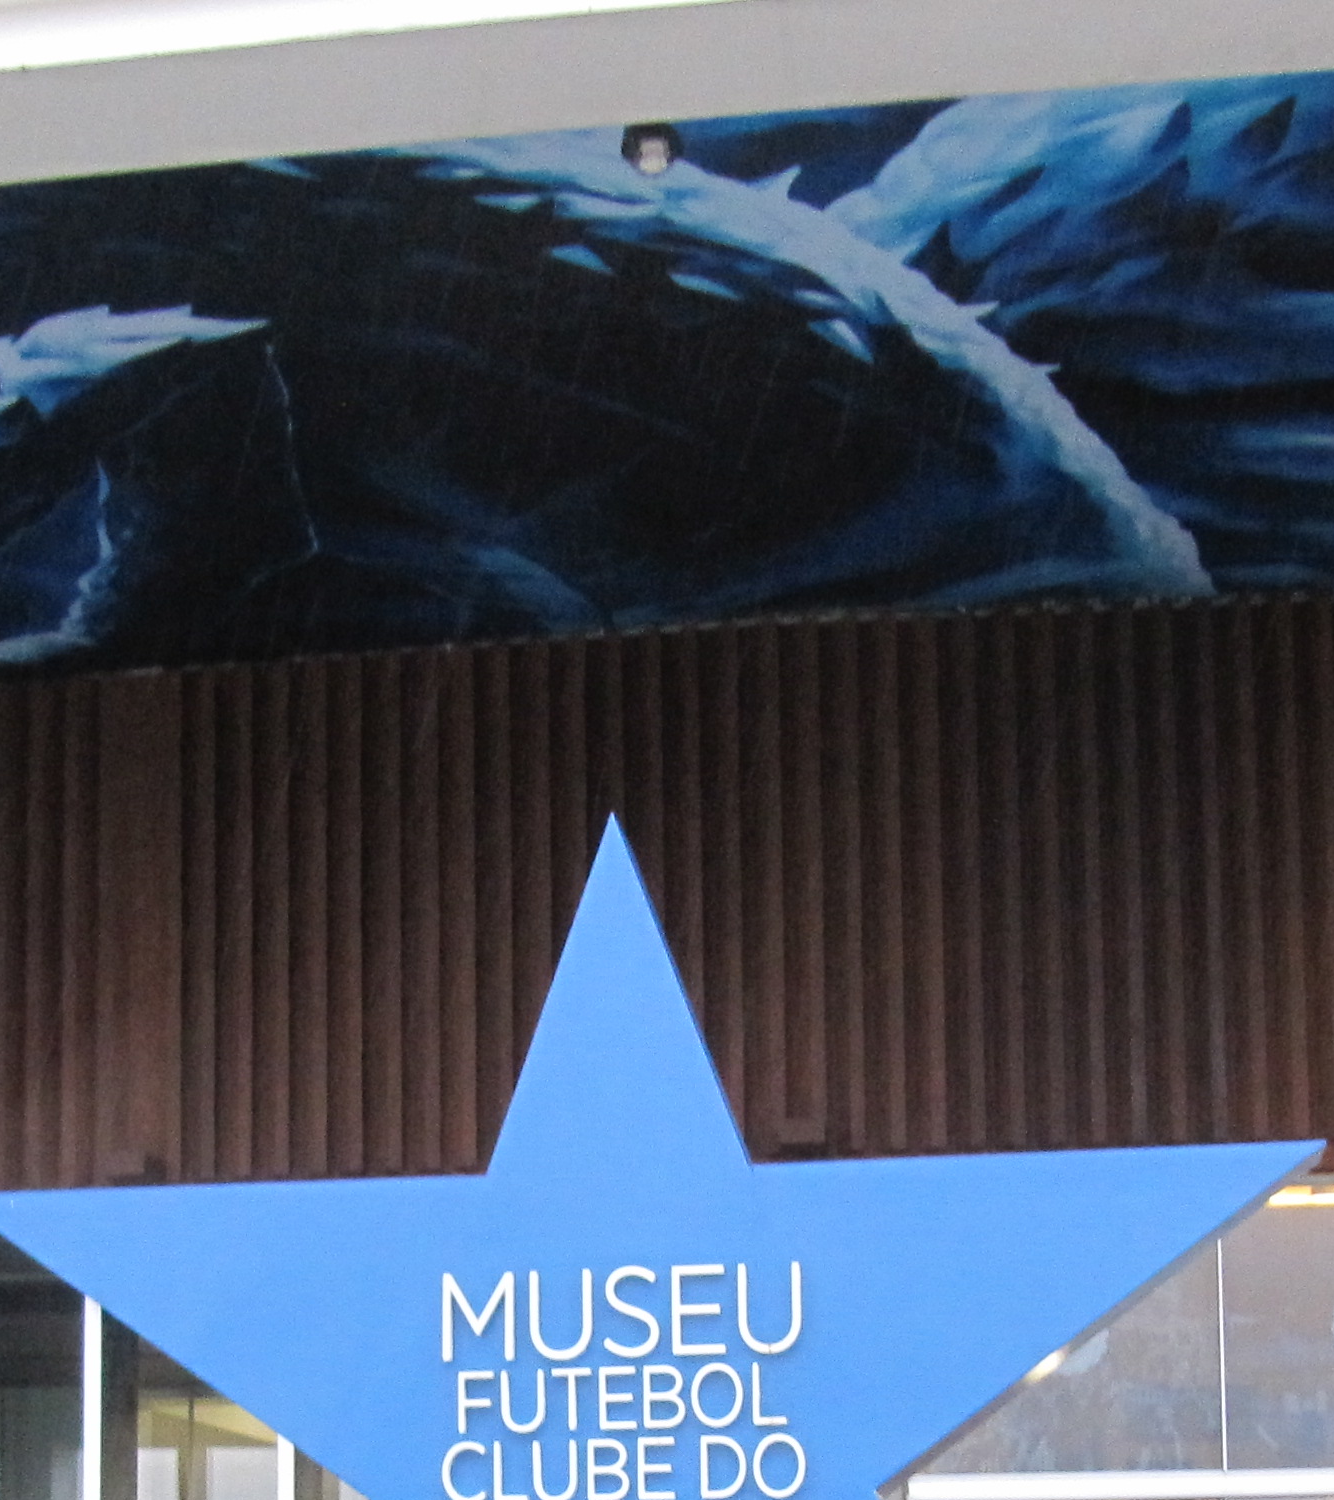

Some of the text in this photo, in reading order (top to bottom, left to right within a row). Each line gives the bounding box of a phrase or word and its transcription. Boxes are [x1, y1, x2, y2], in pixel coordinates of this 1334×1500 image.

[441, 1260, 803, 1363] MUSEU
[457, 1361, 788, 1435] FUTEBOL
[699, 1432, 807, 1500] DO
